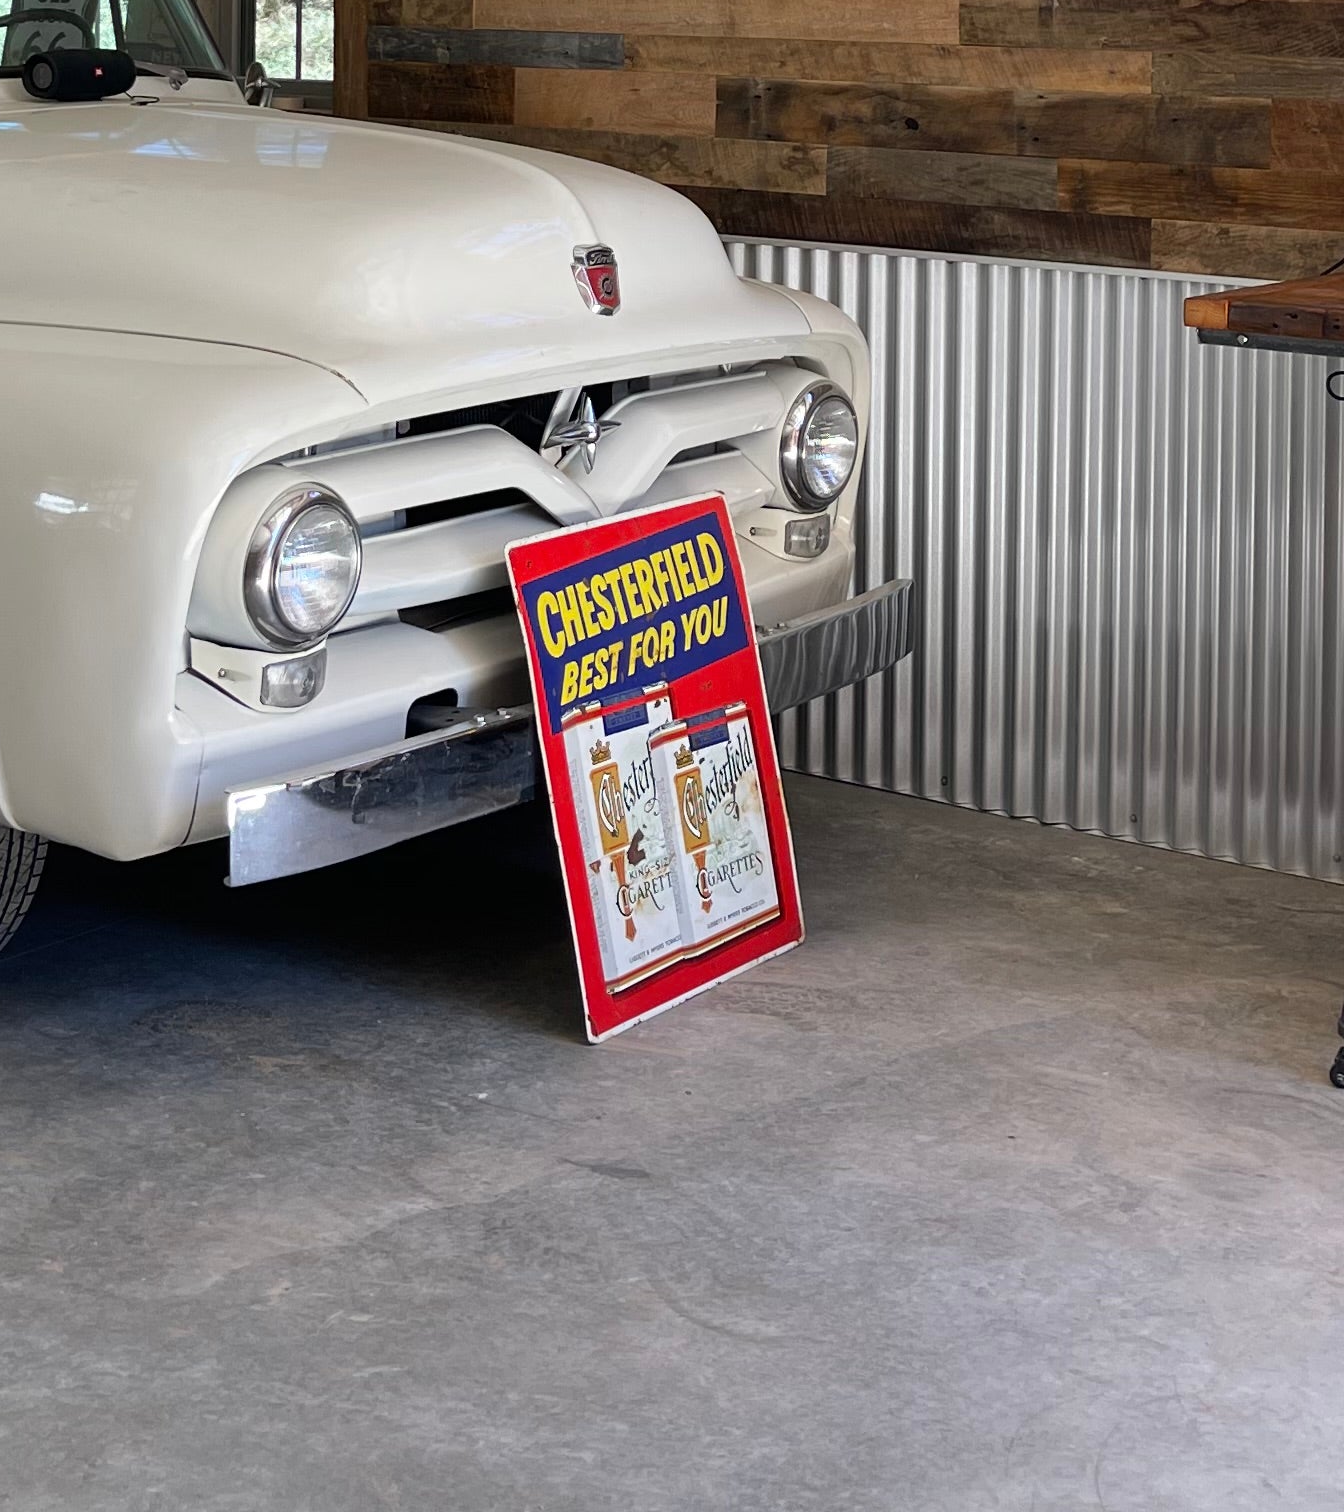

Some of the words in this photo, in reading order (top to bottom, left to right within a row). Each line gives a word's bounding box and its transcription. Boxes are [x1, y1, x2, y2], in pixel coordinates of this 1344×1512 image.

[537, 533, 724, 658] CHESTERFIELD
[560, 640, 624, 706] BEST
[628, 620, 676, 677] FOR
[681, 596, 728, 652] YOU
[682, 723, 754, 839] Chesterfield
[616, 872, 673, 917] CIGARETT
[629, 855, 670, 880] KING-SIZ
[696, 850, 764, 900] CIGARETTES
